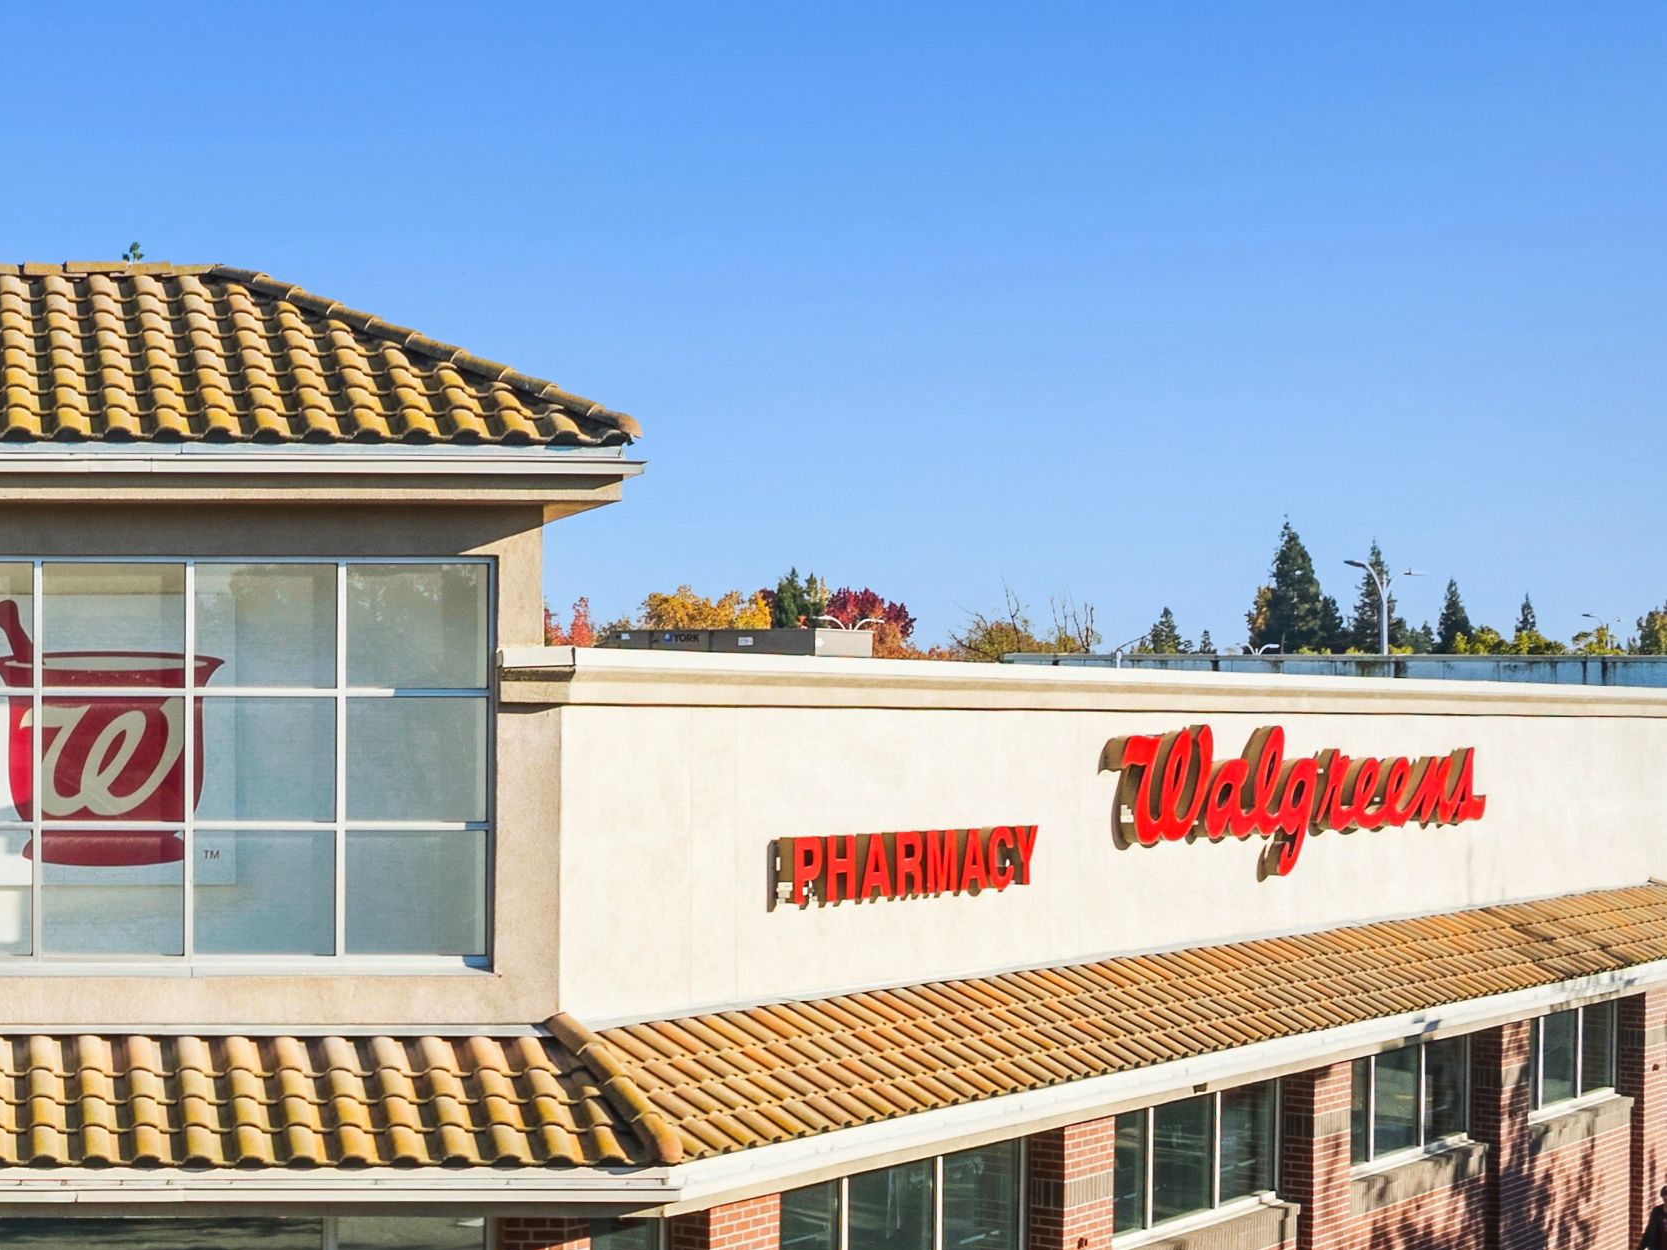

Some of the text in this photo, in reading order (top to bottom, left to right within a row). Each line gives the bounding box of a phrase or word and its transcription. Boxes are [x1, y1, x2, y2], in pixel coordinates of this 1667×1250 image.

[673, 633, 700, 643] YORK
[1110, 724, 1486, 876] Walgreens
[203, 849, 220, 860] TM
[784, 826, 1039, 906] PHARMACY
